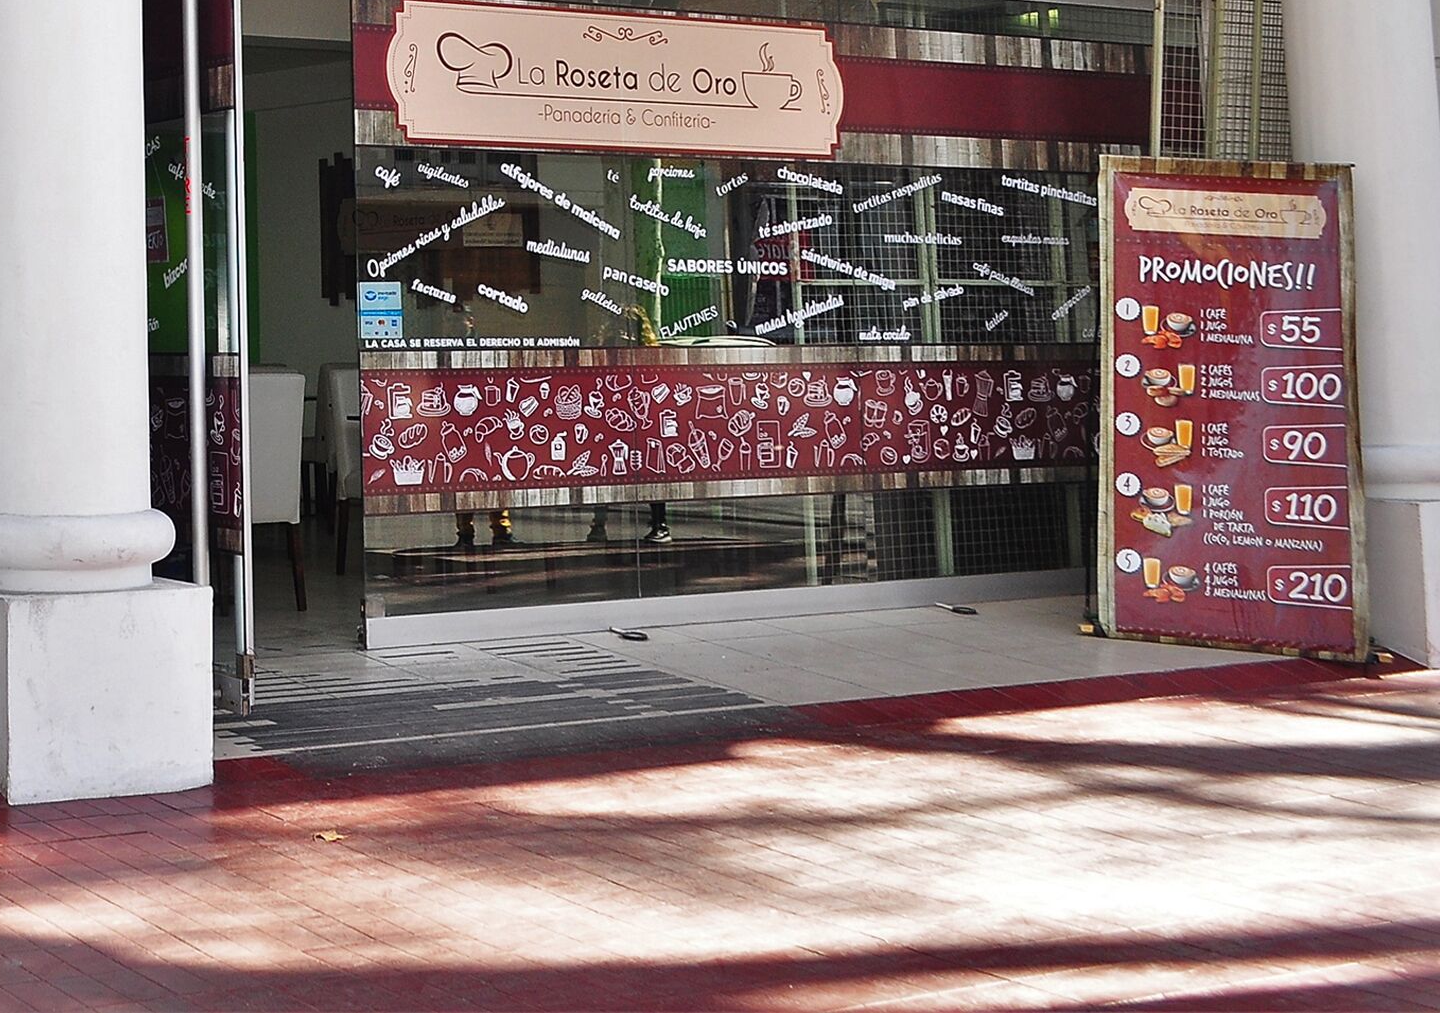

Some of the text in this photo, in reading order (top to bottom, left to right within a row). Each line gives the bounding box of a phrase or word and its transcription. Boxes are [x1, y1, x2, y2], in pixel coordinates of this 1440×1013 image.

[518, 58, 736, 95] La Roseta de Oro
[626, 108, 636, 125] &
[375, 165, 401, 188] café
[418, 162, 469, 188] vigilantes
[607, 169, 619, 183] té
[648, 166, 695, 182] porciones
[778, 167, 843, 194] chocolatada
[716, 173, 748, 197] tortas
[1002, 174, 1097, 207] tortitas pinchaditas
[501, 162, 620, 240] alfajores de maicena
[853, 173, 942, 214] tortitas raspaditas
[942, 191, 1003, 216] masas finas
[629, 194, 707, 239] tortitas de hoja
[1191, 206, 1229, 216] Roseta
[1234, 207, 1249, 217] de
[1255, 208, 1278, 219] Oro
[759, 214, 832, 238] té saborizado
[368, 244, 415, 278] Opciones
[415, 228, 441, 249] ricas
[441, 222, 451, 241] y
[451, 195, 505, 229] saludables
[884, 232, 961, 245] muchas delicias
[527, 240, 590, 263] medialunas
[668, 257, 788, 275] SABORES ÚNICOS
[802, 248, 852, 275] sándwich
[853, 265, 867, 280] de
[869, 273, 895, 291] miga
[1139, 256, 1315, 290] PROMOCIONES!!
[604, 267, 669, 296] pan casero
[411, 279, 456, 304] facturas
[478, 284, 528, 313] cortado
[581, 288, 622, 315] galletas
[903, 298, 919, 311] pan
[921, 291, 932, 303] de
[660, 306, 718, 338] FLAUTINES
[1206, 309, 1227, 320] CAFÉ
[755, 315, 786, 335] masas
[1205, 321, 1227, 330] JUGO
[365, 340, 378, 348] LA
[381, 339, 406, 347] CASA
[410, 339, 422, 347] SE
[424, 339, 463, 347] RESERVA
[480, 338, 520, 347] DERECHO
[523, 338, 535, 346] DE
[537, 337, 580, 347] ADMISIÓN
[1206, 333, 1253, 344] MEDIALUNA
[1124, 360, 1131, 372] 2
[1200, 365, 1232, 376] 2 CAFÉS
[1200, 377, 1233, 388] 2 JUGOS
[1200, 389, 1260, 402] 2 MEDIALUNAS
[1124, 416, 1132, 429] 3
[1207, 423, 1228, 434] CAFÉ
[1206, 436, 1229, 446] JUGO
[1209, 448, 1244, 459] TOSTADO
[1123, 477, 1131, 491] 4
[1208, 484, 1229, 495] CAFÉ
[1208, 497, 1230, 507] JUGO
[1210, 509, 1244, 520] PORCIÓN
[1214, 523, 1255, 533] DE TARTA
[1232, 535, 1263, 547] LEMON
[1124, 553, 1132, 567] 5
[1204, 562, 1237, 574] 4 CAFÉS
[1212, 576, 1238, 586] JUGOS
[1213, 588, 1265, 601] MEDIALUNAS
